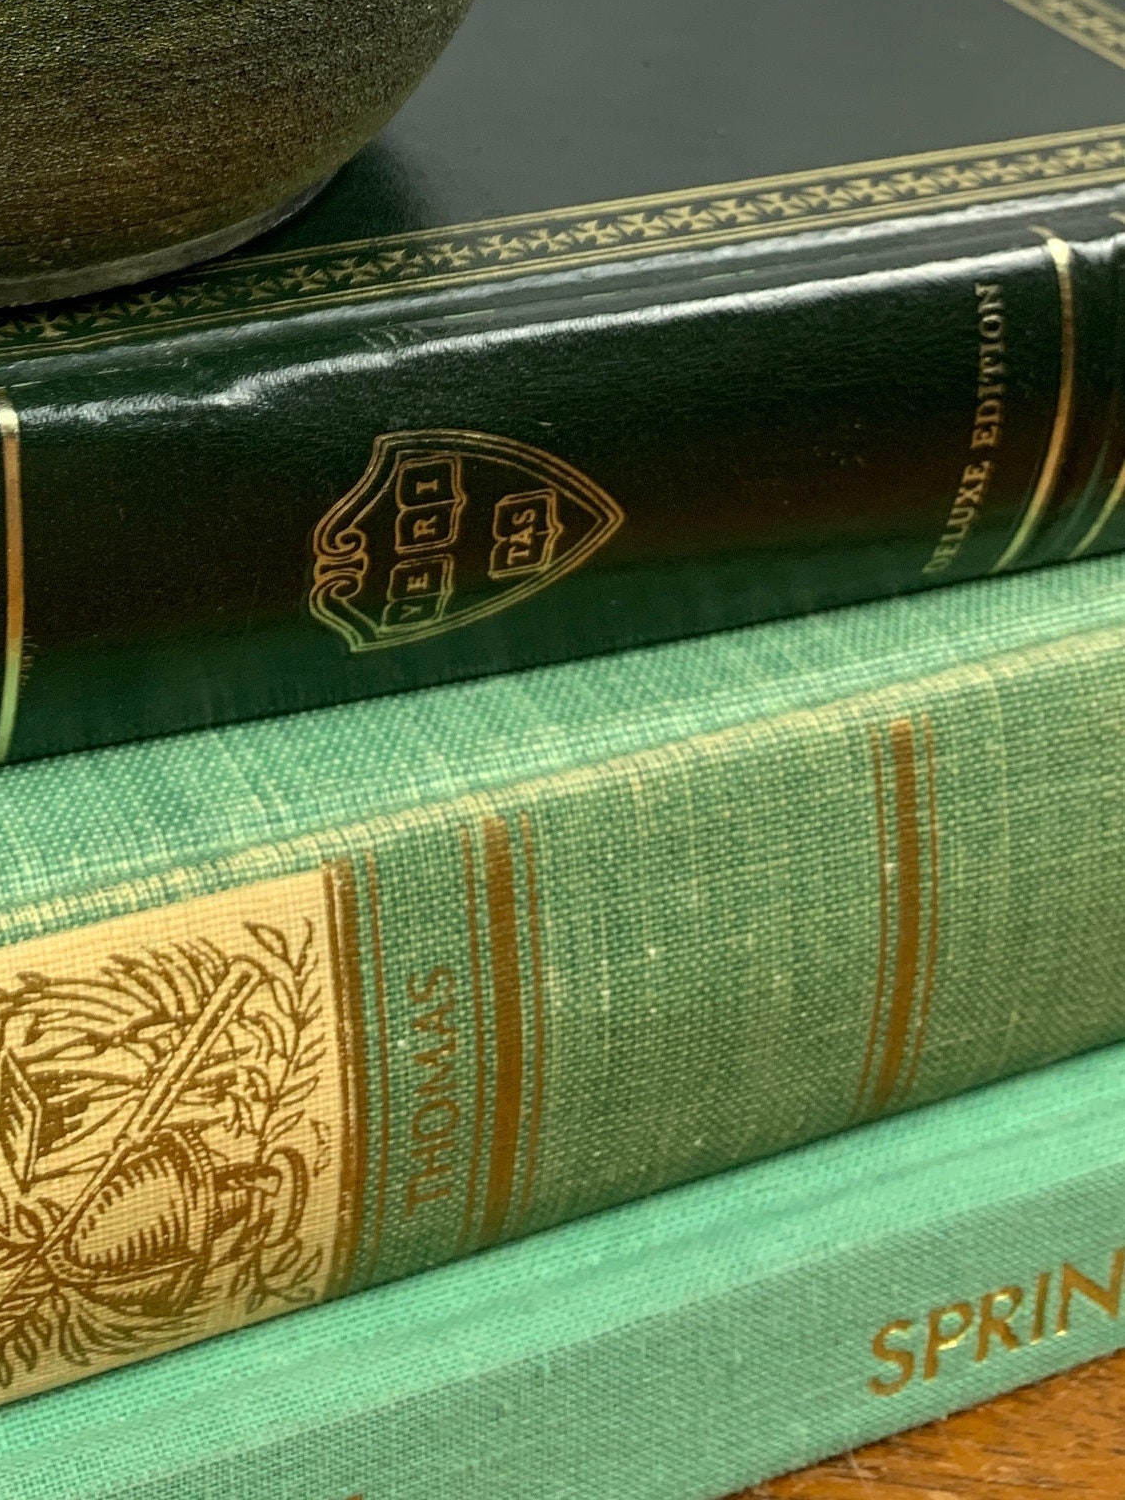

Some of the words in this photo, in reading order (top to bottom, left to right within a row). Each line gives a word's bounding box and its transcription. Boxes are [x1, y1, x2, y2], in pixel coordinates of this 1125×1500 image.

[922, 460, 993, 575] DELUXE
[970, 282, 1006, 450] EDITION
[507, 508, 537, 565] TAS
[405, 967, 460, 1219] THOMAS
[866, 1247, 1125, 1397] SPRIN
